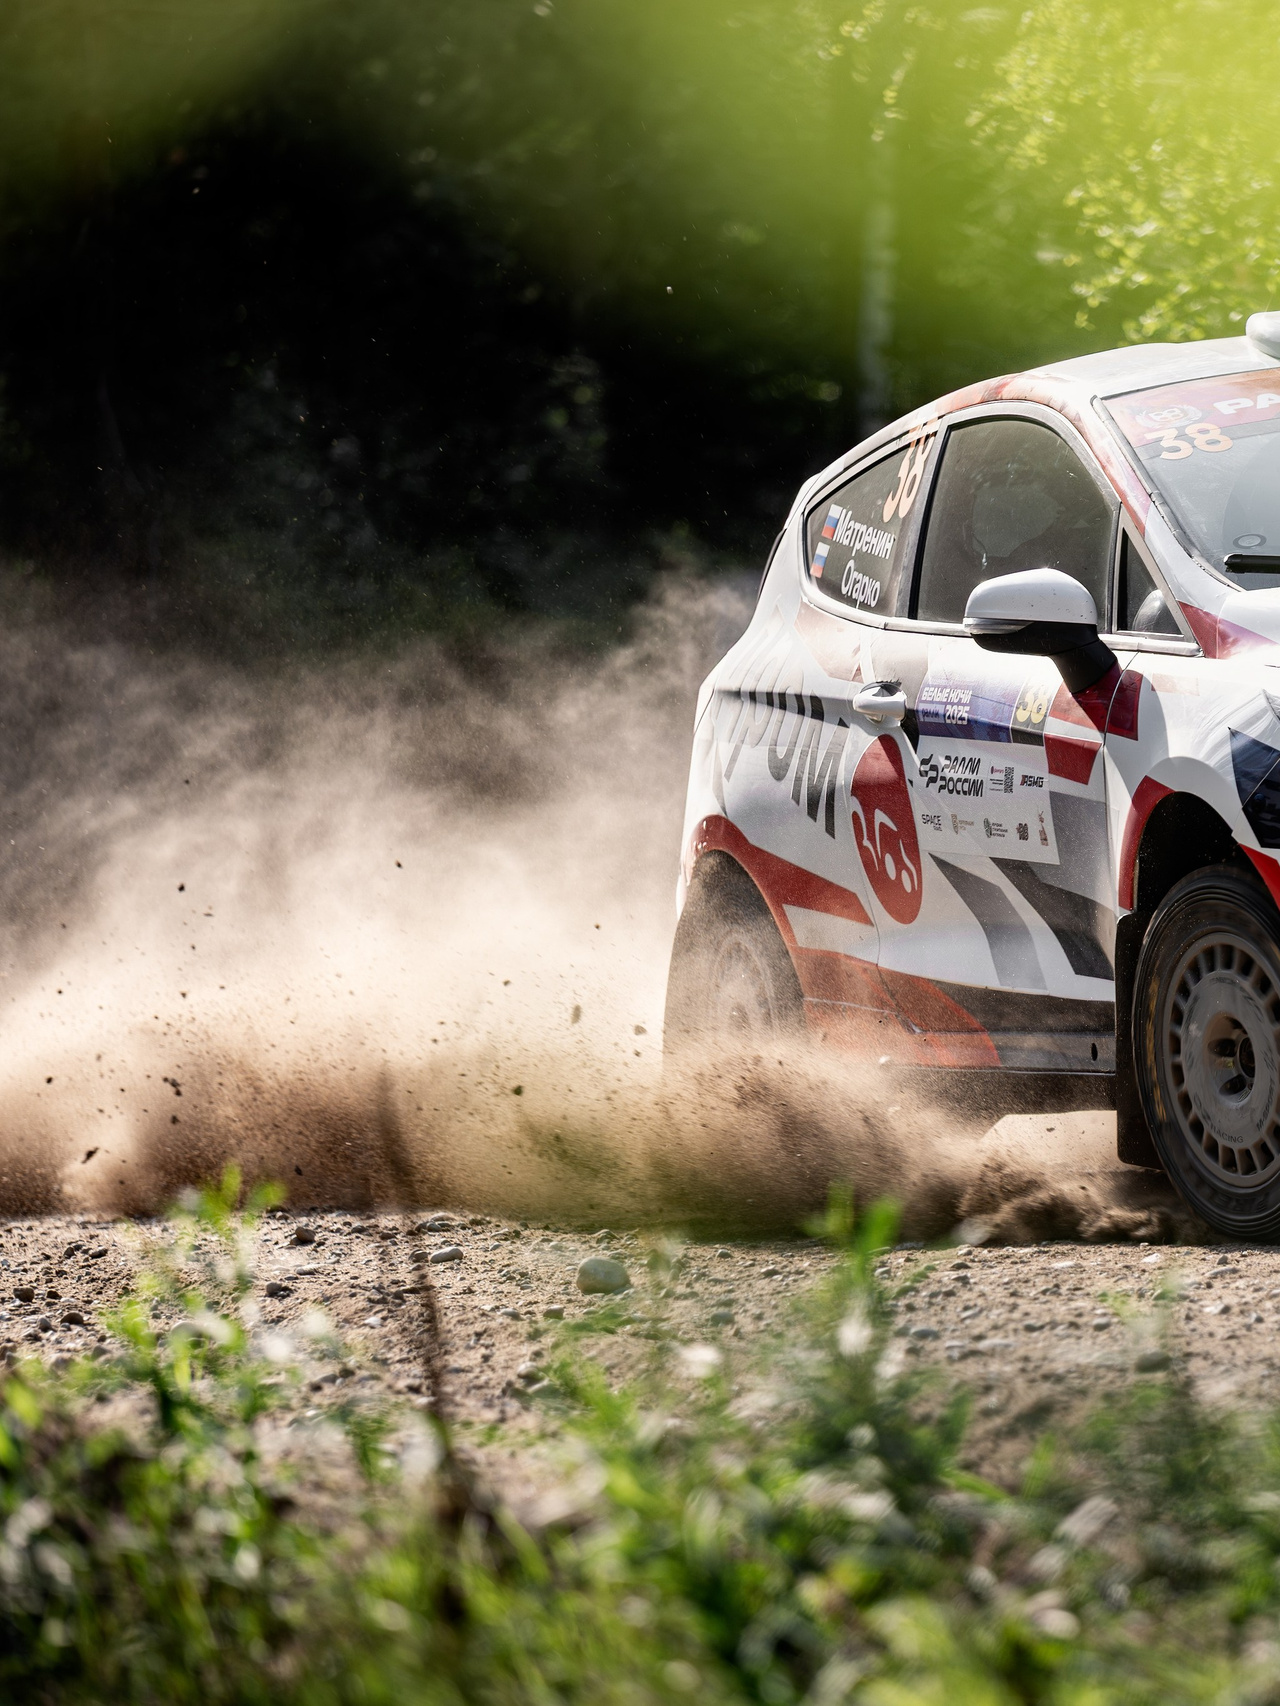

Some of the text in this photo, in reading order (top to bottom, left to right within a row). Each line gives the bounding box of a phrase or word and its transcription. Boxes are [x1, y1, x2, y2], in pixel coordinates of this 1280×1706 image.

[1144, 422, 1233, 460] 38
[832, 508, 895, 559] Матренин
[841, 559, 880, 609] Огарко
[921, 687, 972, 704] БЕЛЫЕ НОЧИ
[945, 705, 970, 725] 2025
[941, 755, 981, 776] РАЛЛИ
[938, 776, 984, 797] РОССИИ
[921, 814, 942, 826] SPACE
